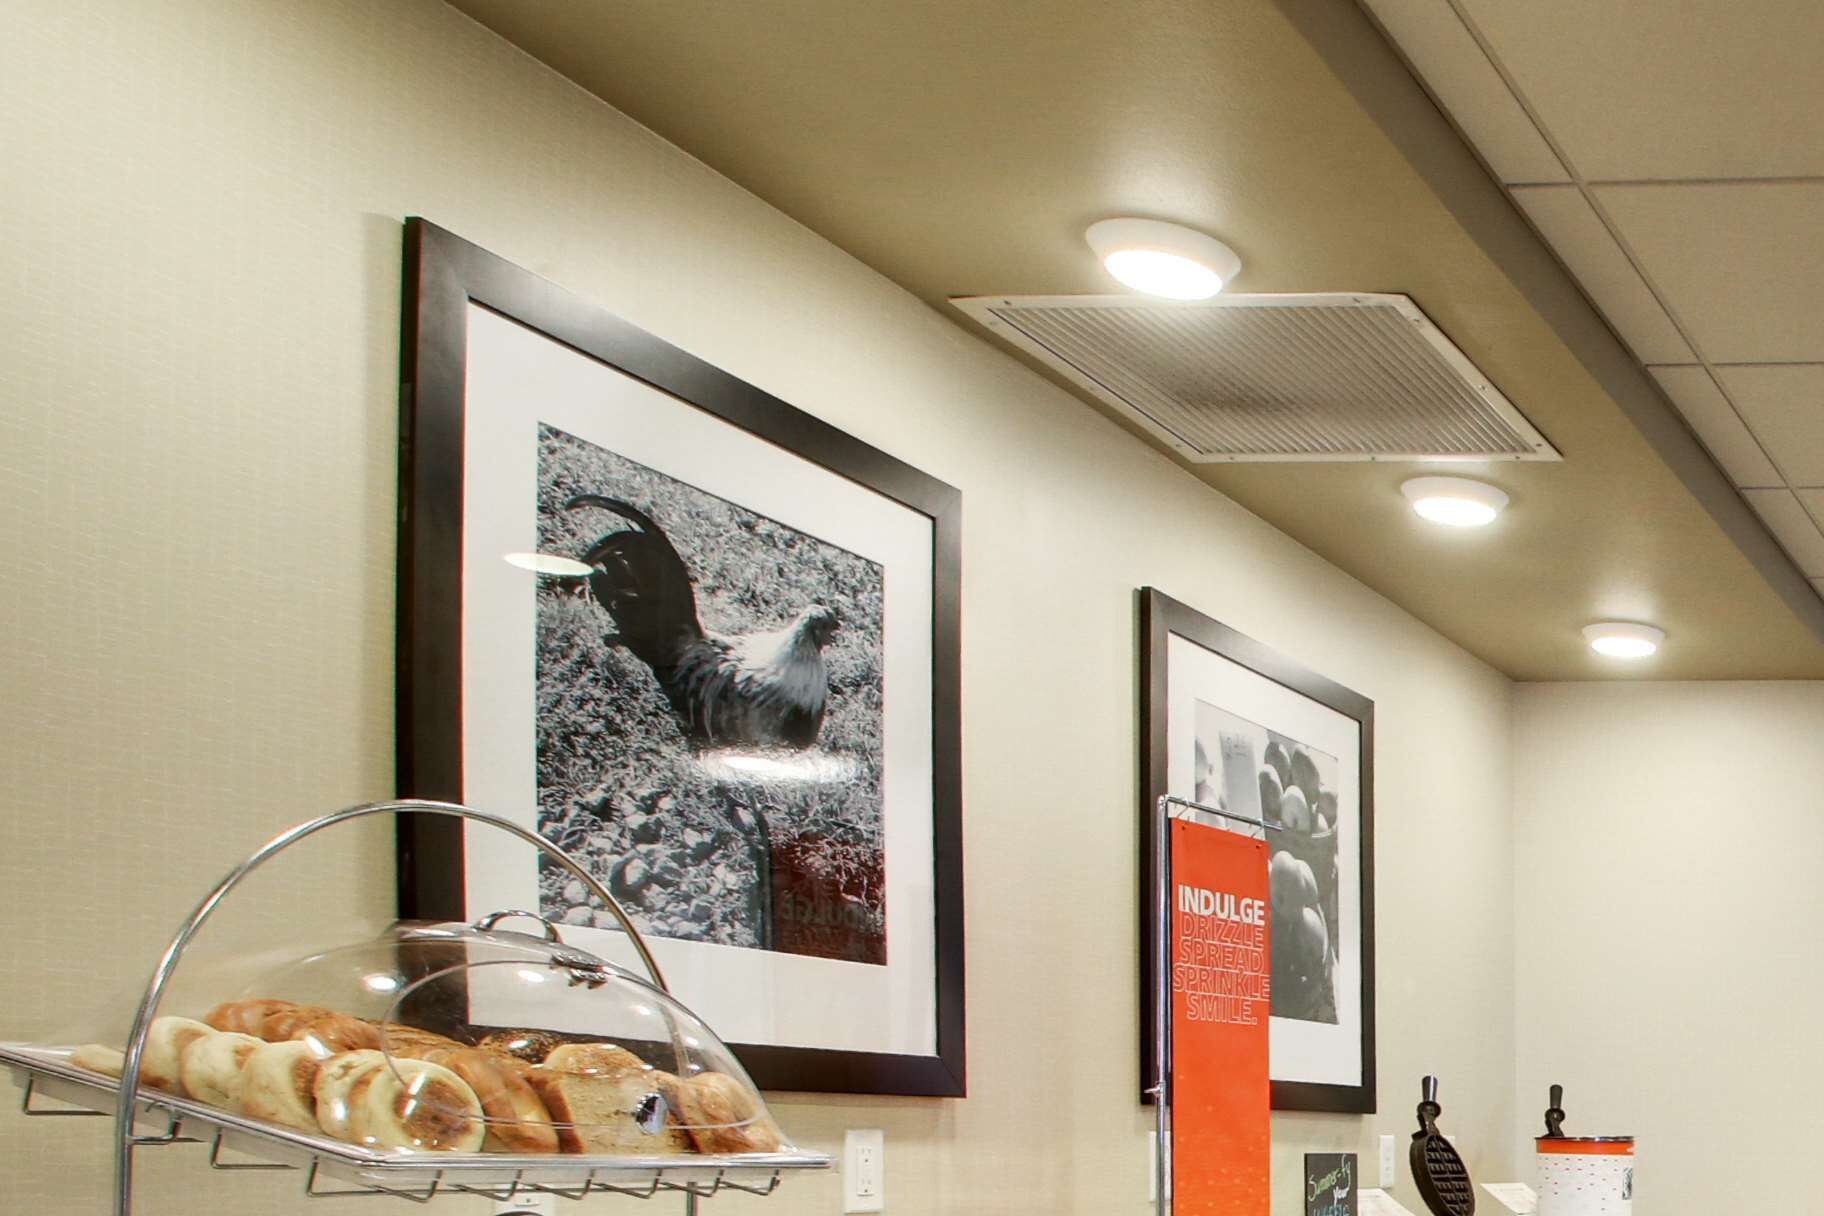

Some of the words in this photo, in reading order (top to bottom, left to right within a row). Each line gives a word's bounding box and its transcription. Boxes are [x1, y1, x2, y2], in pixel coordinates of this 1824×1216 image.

[1178, 884, 1265, 925] INDULGE
[1182, 911, 1264, 950] DRIZZLE
[1180, 936, 1264, 976] SPREAD
[1173, 962, 1270, 1001] SPRINKLE
[1186, 991, 1258, 1025] SMILE.
